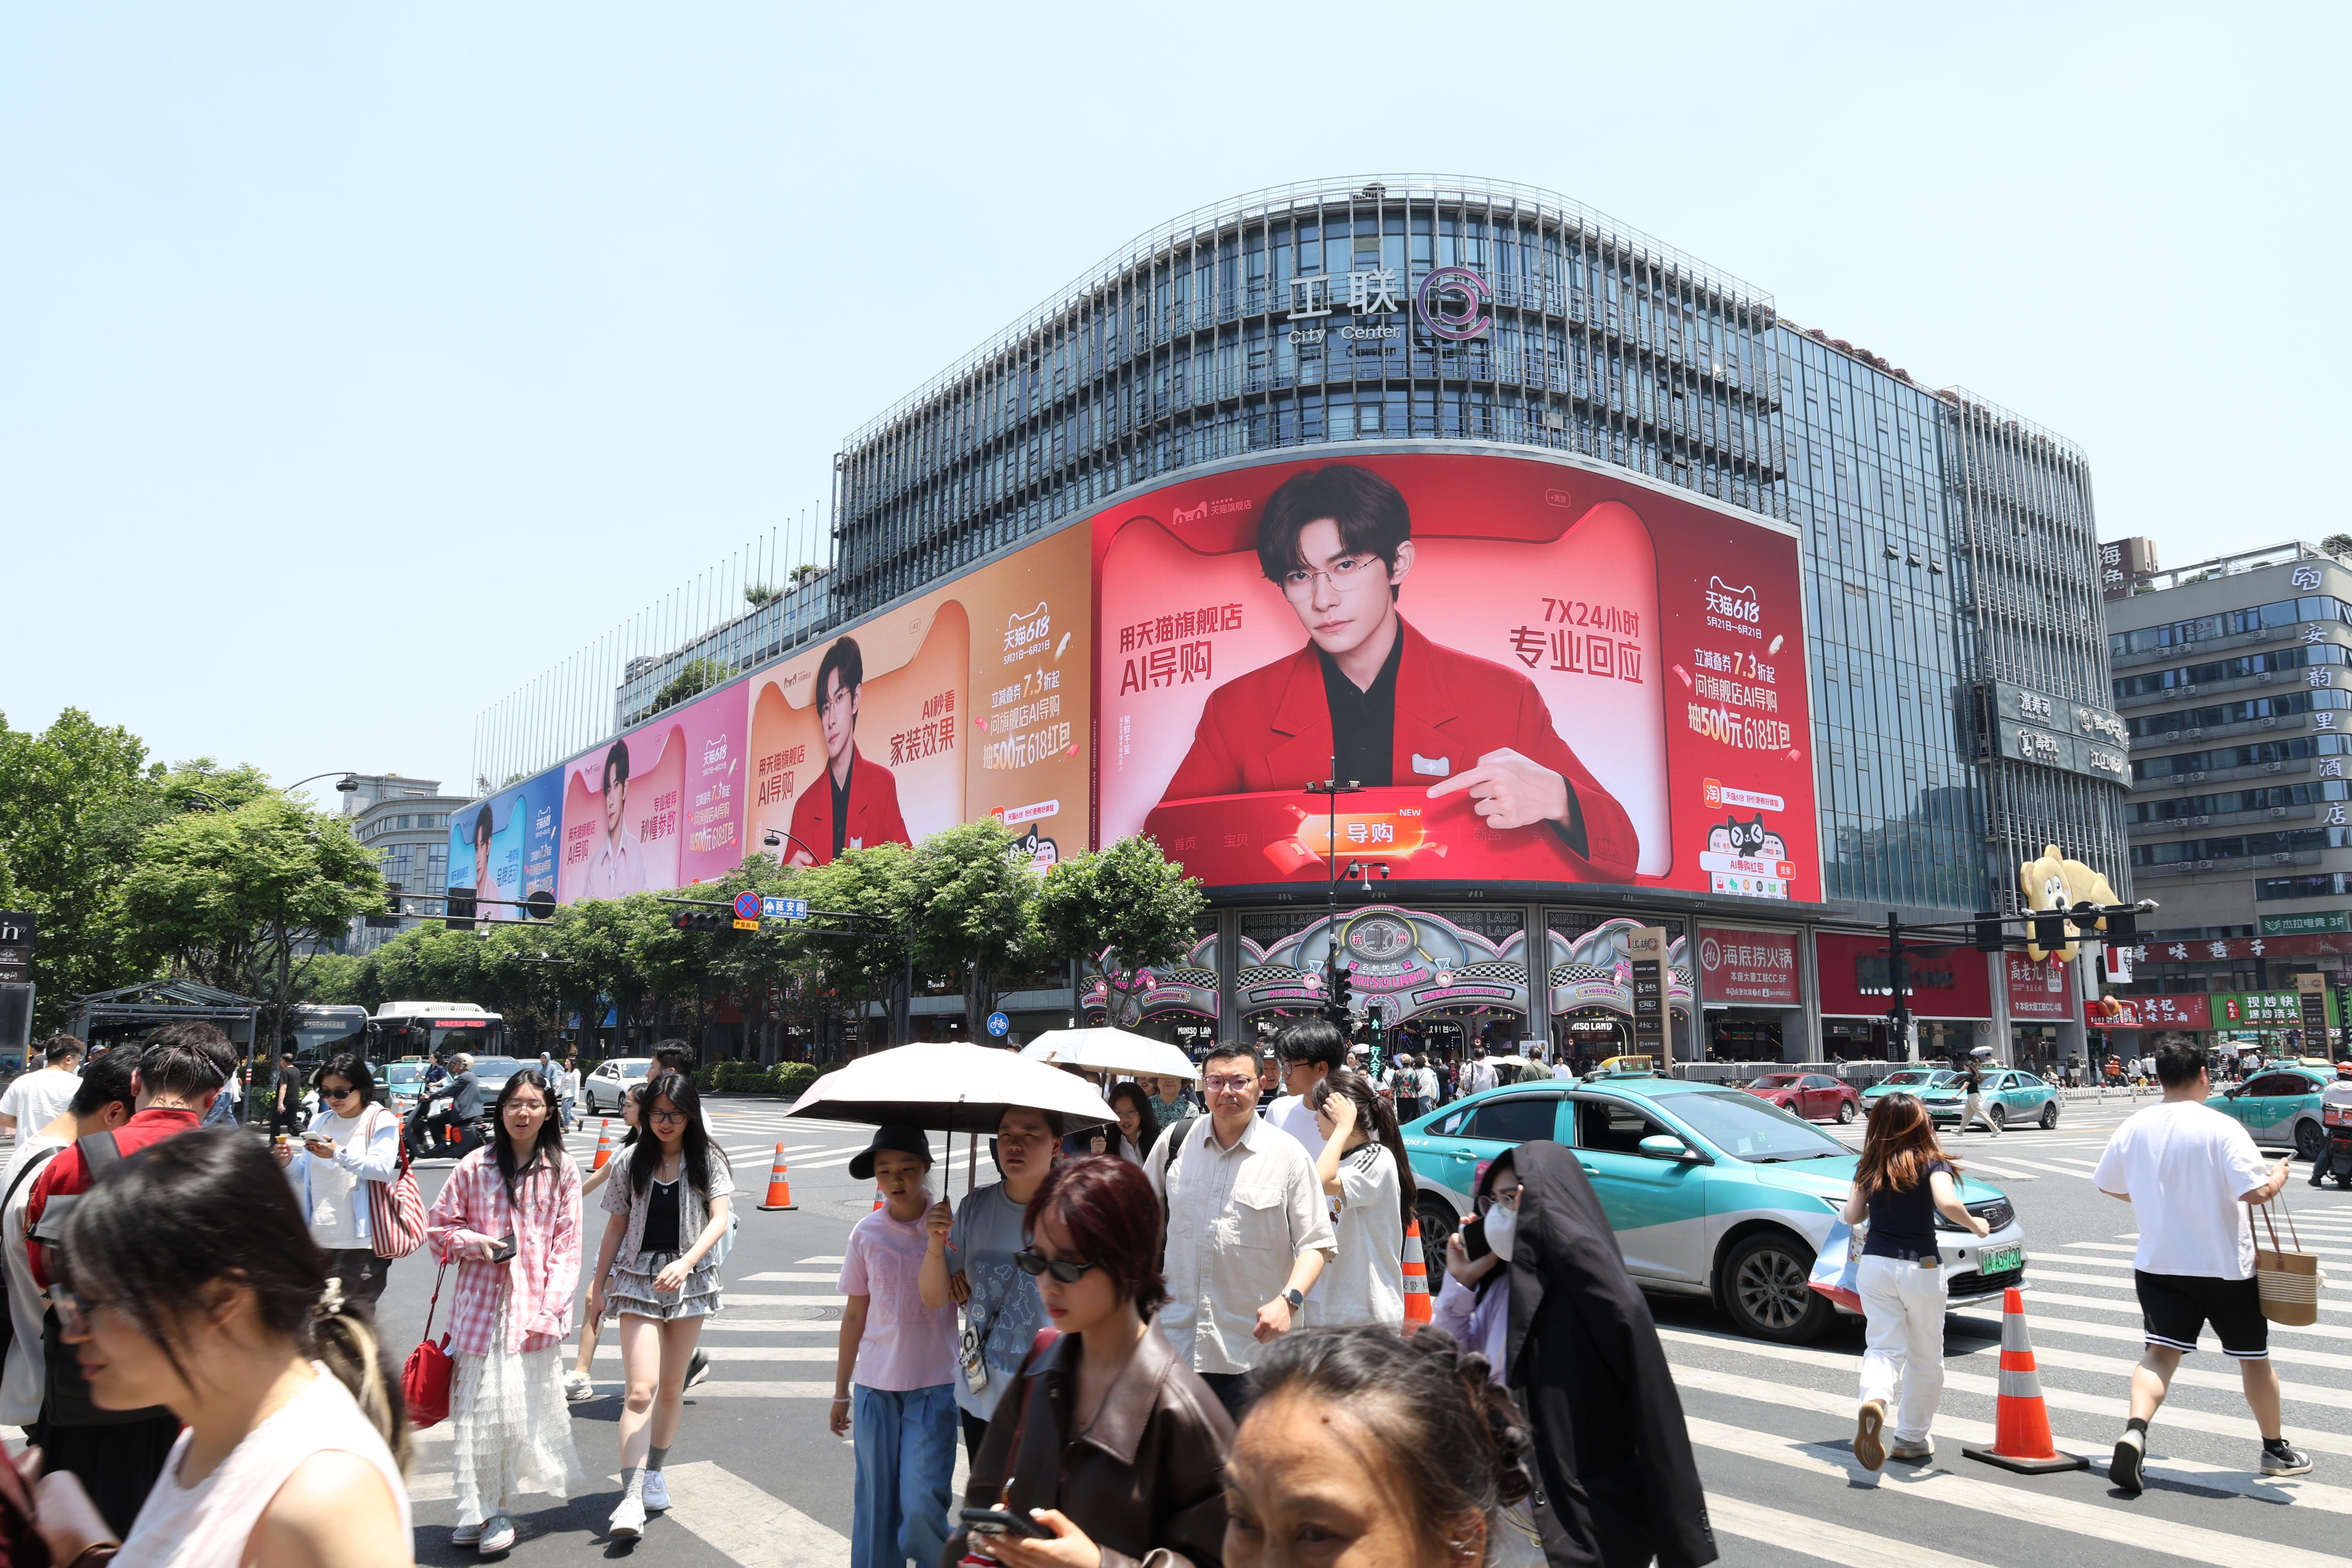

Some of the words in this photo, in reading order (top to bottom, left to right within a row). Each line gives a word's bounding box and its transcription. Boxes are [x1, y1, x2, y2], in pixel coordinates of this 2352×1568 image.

[1287, 268, 1398, 319] 工联
[1288, 327, 1326, 344] City
[1341, 325, 1400, 339] Center
[1211, 499, 1252, 516] 天猫旗舰店
[1706, 590, 1759, 623] 天猫618
[1541, 598, 1639, 638] 7X24小时
[1004, 615, 1050, 652] 天猫618
[1119, 603, 1242, 654] 用天猫旗舰店
[1510, 626, 1643, 684] 专业回应
[1120, 641, 1212, 697] AI导购
[1695, 673, 1777, 713] 问旗舰店AI导购
[922, 689, 955, 720] AI秒看
[990, 695, 1060, 737] 问旗舰店AI导购
[2300, 623, 2348, 825] 安韵里酒店
[890, 715, 955, 767] 家装效果
[2033, 733, 2059, 753] 高老九
[703, 744, 727, 766] 天猫618
[759, 744, 806, 777] 用天猫旗舰店
[758, 770, 794, 808] AI导购
[1706, 785, 1720, 803] 淘
[654, 790, 677, 813] 专业推荐
[1726, 792, 1744, 802] 天猫618
[1747, 795, 1779, 807] 好价更有好体验
[694, 802, 730, 827] 问旗舰店AI导购
[1008, 812, 1024, 820] 天猫618
[1399, 809, 1421, 817] NEW
[568, 820, 596, 842] 用天猫旗舰店
[640, 809, 676, 844] 秒懂参数
[1346, 822, 1394, 844] 导购
[1474, 827, 1501, 841] 新品
[1174, 836, 1196, 850] 首页
[1224, 833, 1249, 848] 宝贝
[567, 839, 588, 866] AI导购
[1730, 860, 1764, 873] AI导购红包
[1780, 865, 1791, 875] 搜索
[776, 901, 805, 913] 延安路
[1245, 915, 1286, 927] MINISO
[1486, 912, 1518, 923] LAND
[1550, 913, 1586, 925] MINISO
[1590, 916, 1611, 926] LAN
[2283, 918, 2326, 929] 杰拉电竞
[2329, 917, 2344, 926] 3F
[1352, 933, 1363, 945] 杭
[1397, 932, 1407, 944] 州
[1632, 938, 1647, 947] 工联
[1704, 944, 1717, 963] Hi
[1722, 944, 1793, 969] 海底捞火锅
[1362, 963, 1399, 972] 名创优品
[1731, 971, 1777, 983] 本座大厦工联CC
[1779, 974, 1787, 983] 5F
[2011, 959, 2043, 981] 高老九
[1345, 973, 1390, 988] INISO
[1392, 968, 1427, 987] LAND
[1268, 989, 1301, 998] MINISO
[2247, 996, 2300, 1008] 现炒快
[2145, 999, 2175, 1012] 吴记
[2249, 1009, 2300, 1020] 爆炒浇头
[1177, 1027, 1197, 1035] MINISO
[1591, 1022, 1612, 1031] LAND
